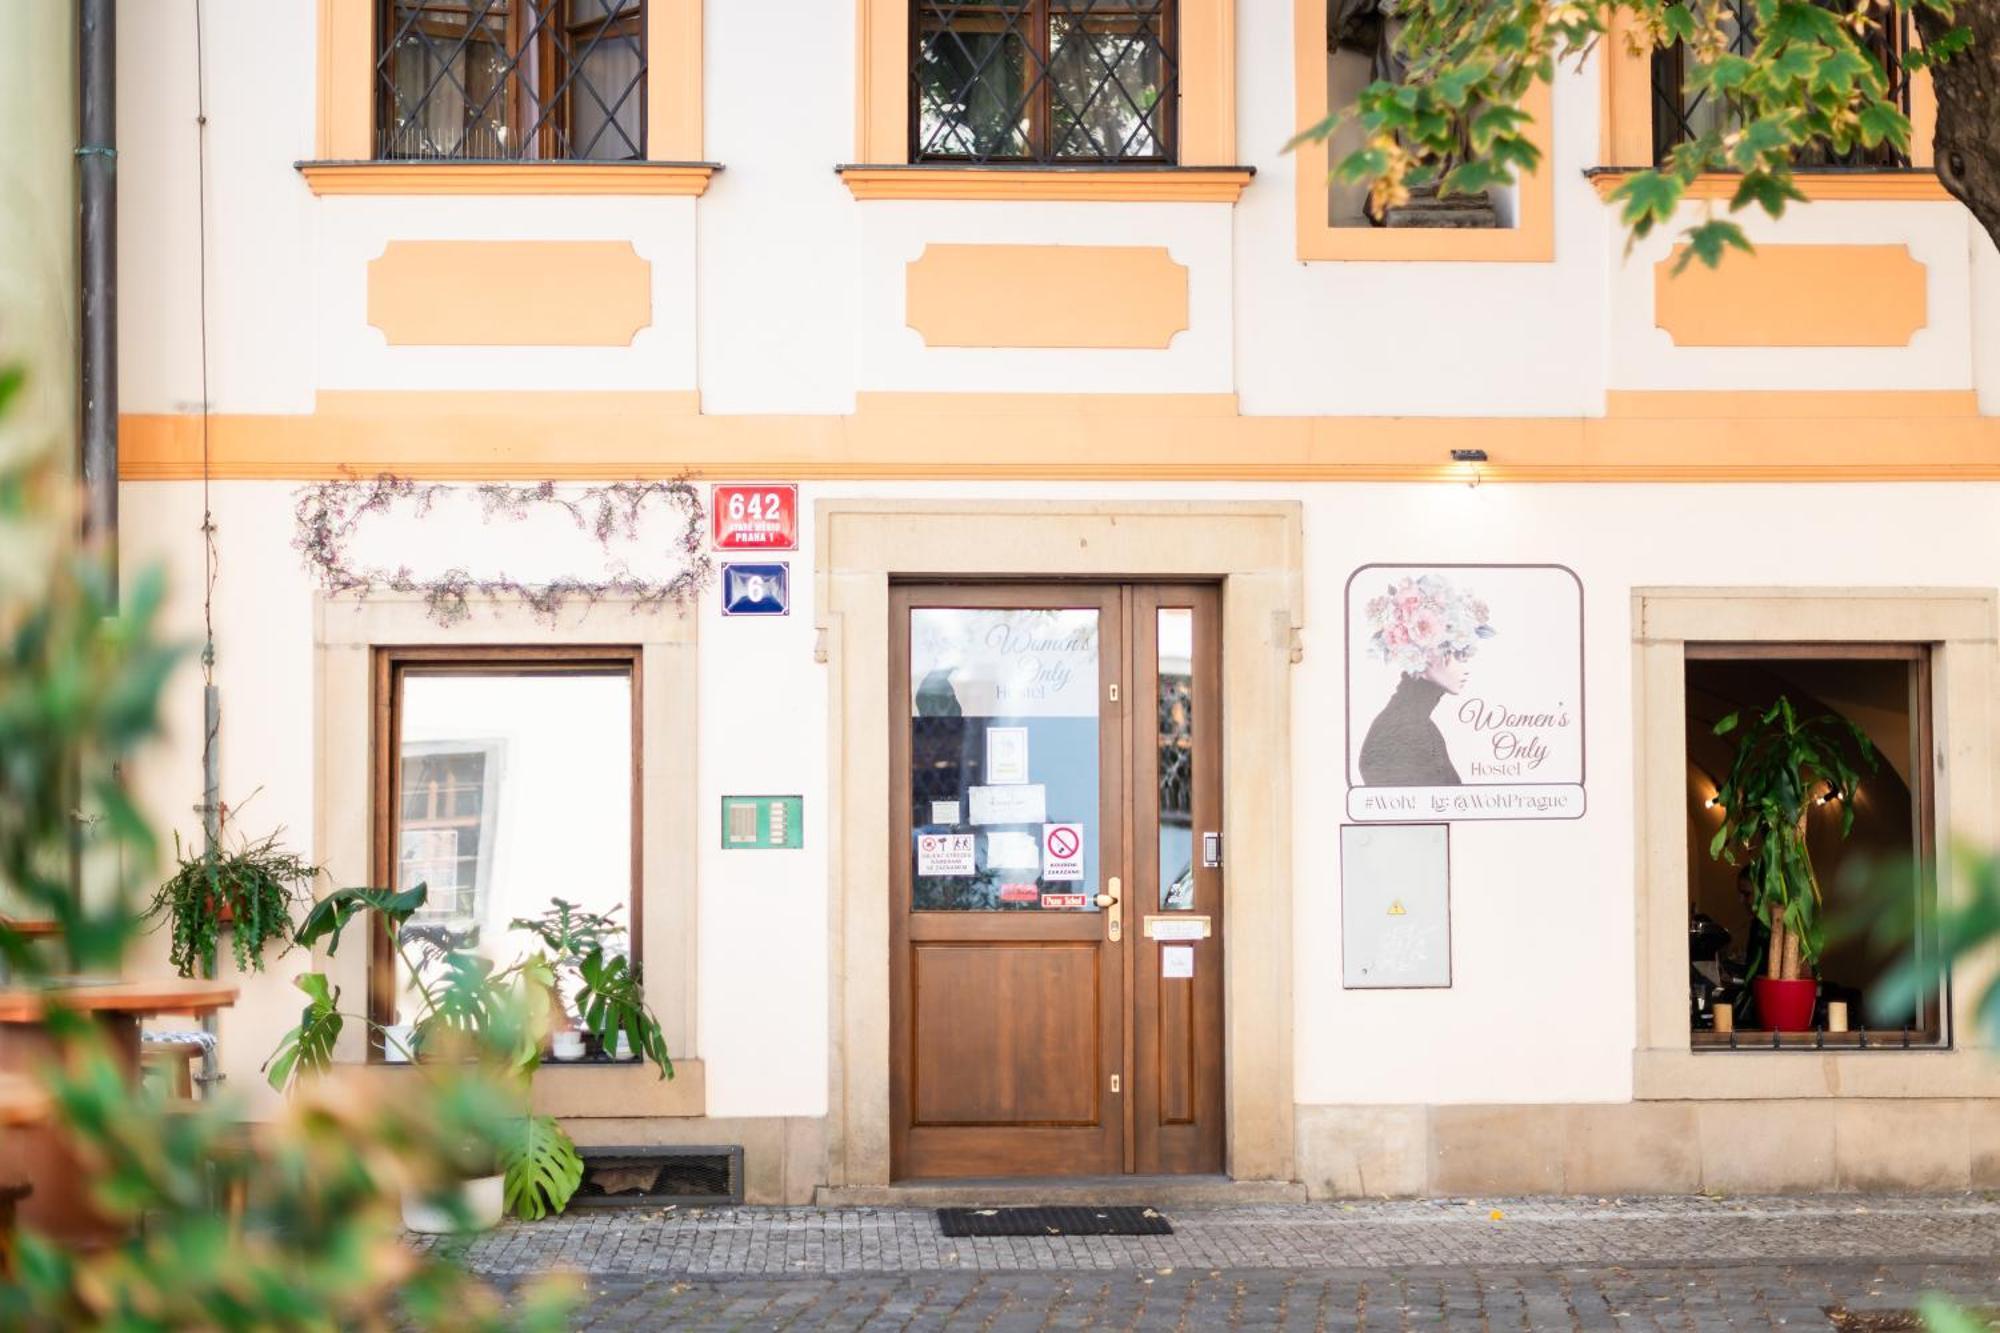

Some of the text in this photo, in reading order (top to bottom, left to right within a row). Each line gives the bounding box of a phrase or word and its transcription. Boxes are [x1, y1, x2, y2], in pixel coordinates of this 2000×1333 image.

[729, 493, 780, 520] 642
[735, 532, 774, 543] PRAHA 1
[747, 575, 764, 603] 6
[1458, 697, 1570, 732] Women's
[1492, 730, 1548, 770] Only
[1471, 761, 1521, 777] Hostel
